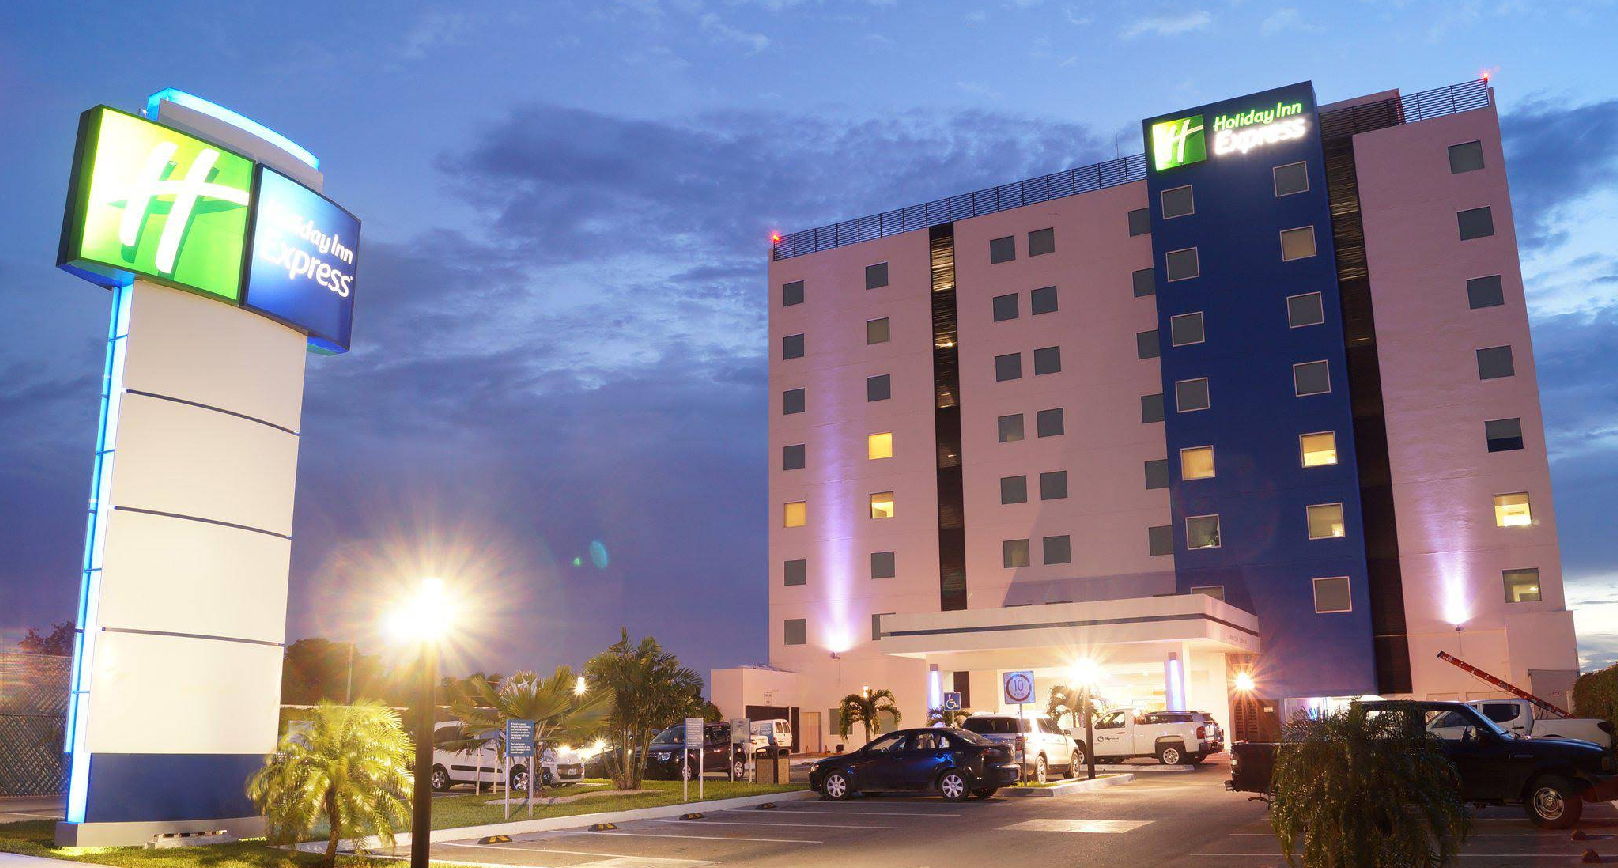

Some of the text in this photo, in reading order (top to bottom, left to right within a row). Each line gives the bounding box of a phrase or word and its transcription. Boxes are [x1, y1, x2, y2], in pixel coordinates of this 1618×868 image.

[1213, 102, 1302, 132] Holiday Inn
[1214, 118, 1306, 155] Express
[331, 234, 354, 265] Inn
[257, 240, 351, 298] Express
[1014, 679, 1024, 692] 10
